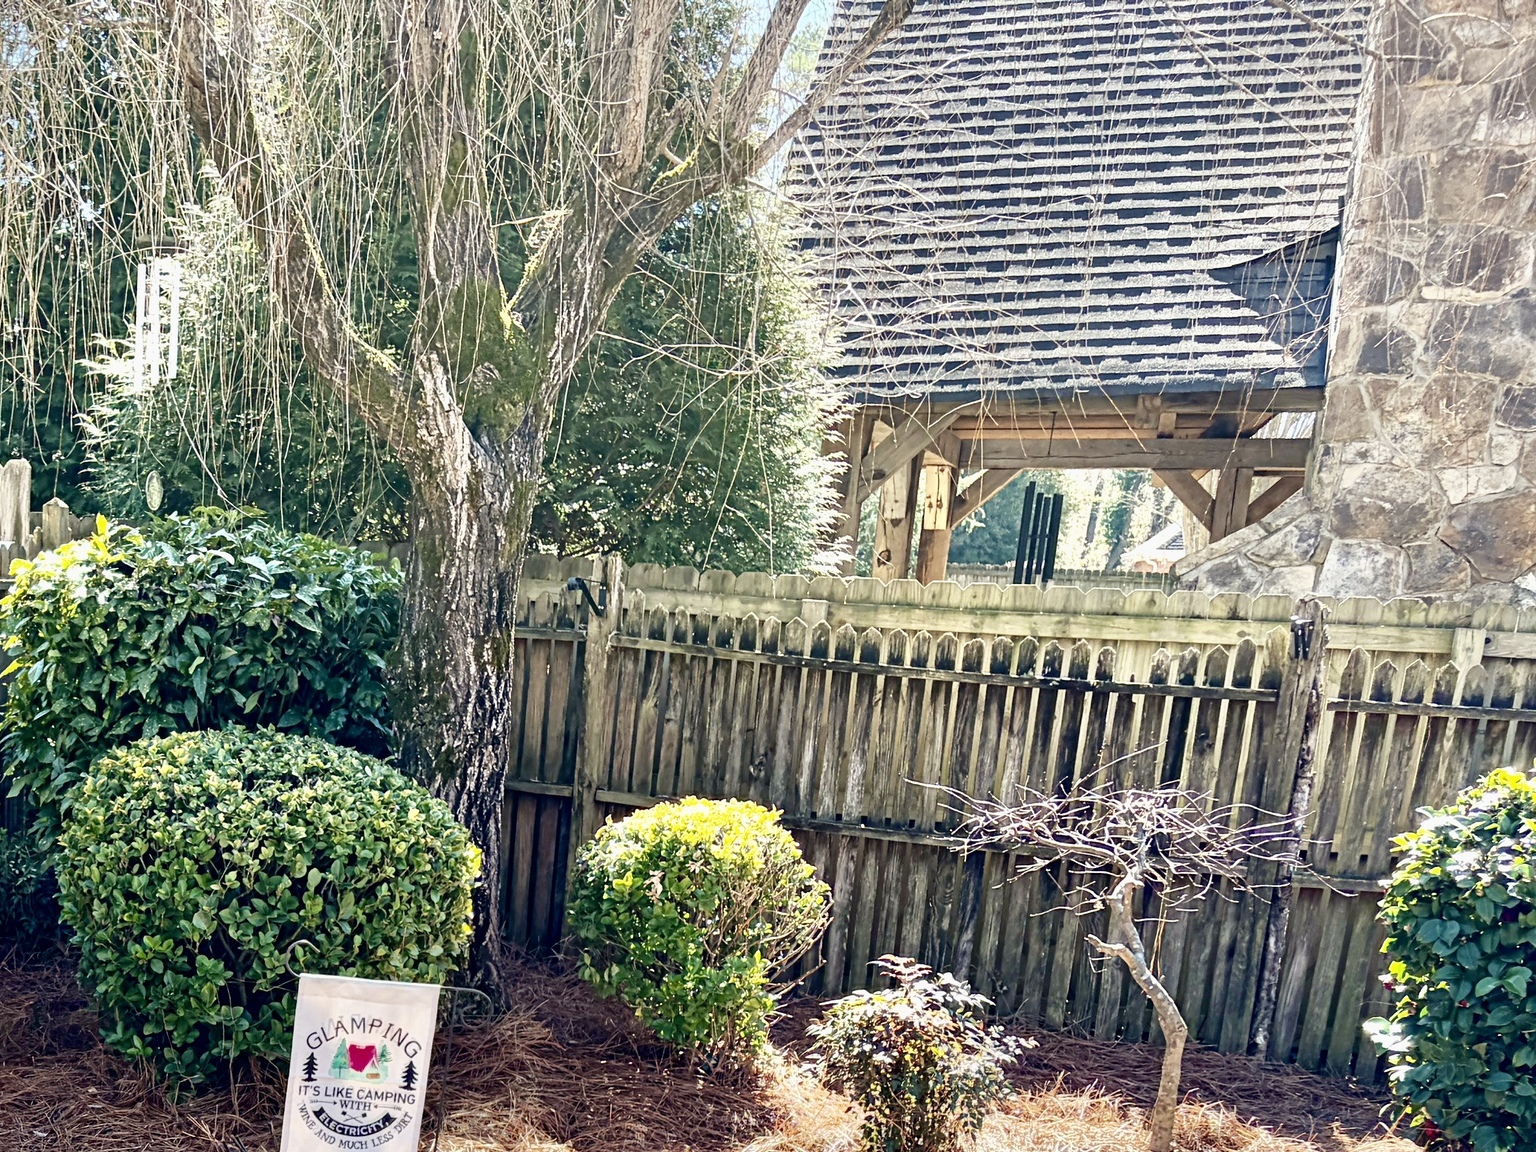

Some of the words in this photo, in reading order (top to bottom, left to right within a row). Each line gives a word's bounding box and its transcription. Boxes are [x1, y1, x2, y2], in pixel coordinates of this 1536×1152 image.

[306, 1017, 422, 1059] GLAMPING
[298, 1085, 321, 1096] IT'S
[324, 1087, 353, 1099] LIKE
[356, 1089, 416, 1105] CAMPING
[339, 1099, 372, 1111] WITH
[298, 1103, 315, 1130] WINE
[314, 1128, 336, 1145] AND
[338, 1139, 368, 1150] MUCH
[372, 1131, 394, 1148] LESS
[394, 1111, 413, 1135] DIRT
